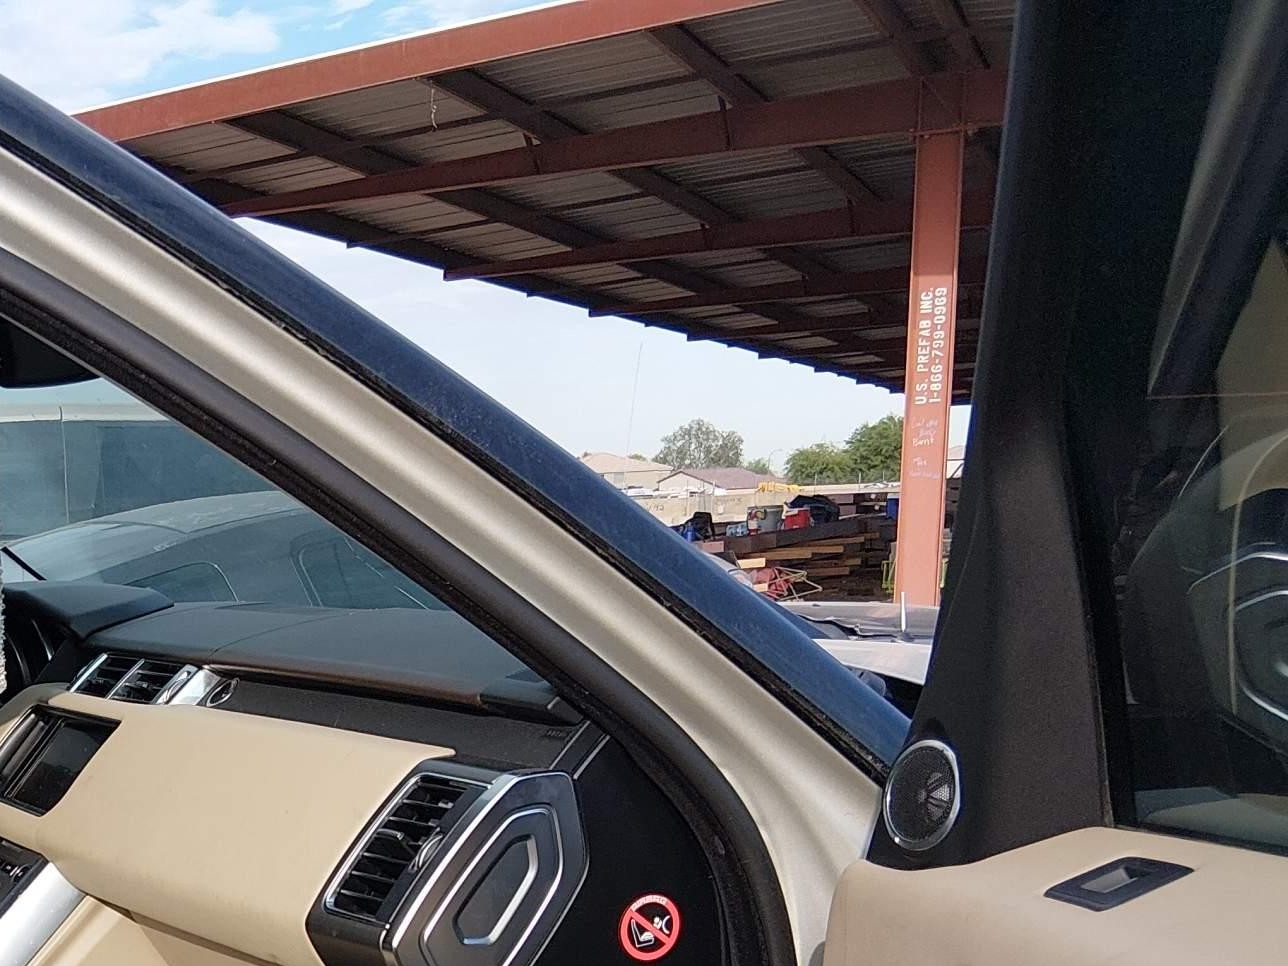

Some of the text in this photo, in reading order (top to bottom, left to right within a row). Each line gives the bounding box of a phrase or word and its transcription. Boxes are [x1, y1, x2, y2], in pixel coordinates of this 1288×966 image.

[919, 287, 934, 314] INC.
[916, 320, 931, 372] PREFAB
[928, 287, 948, 403] 1-866-799-0969
[914, 378, 929, 405] U.S.
